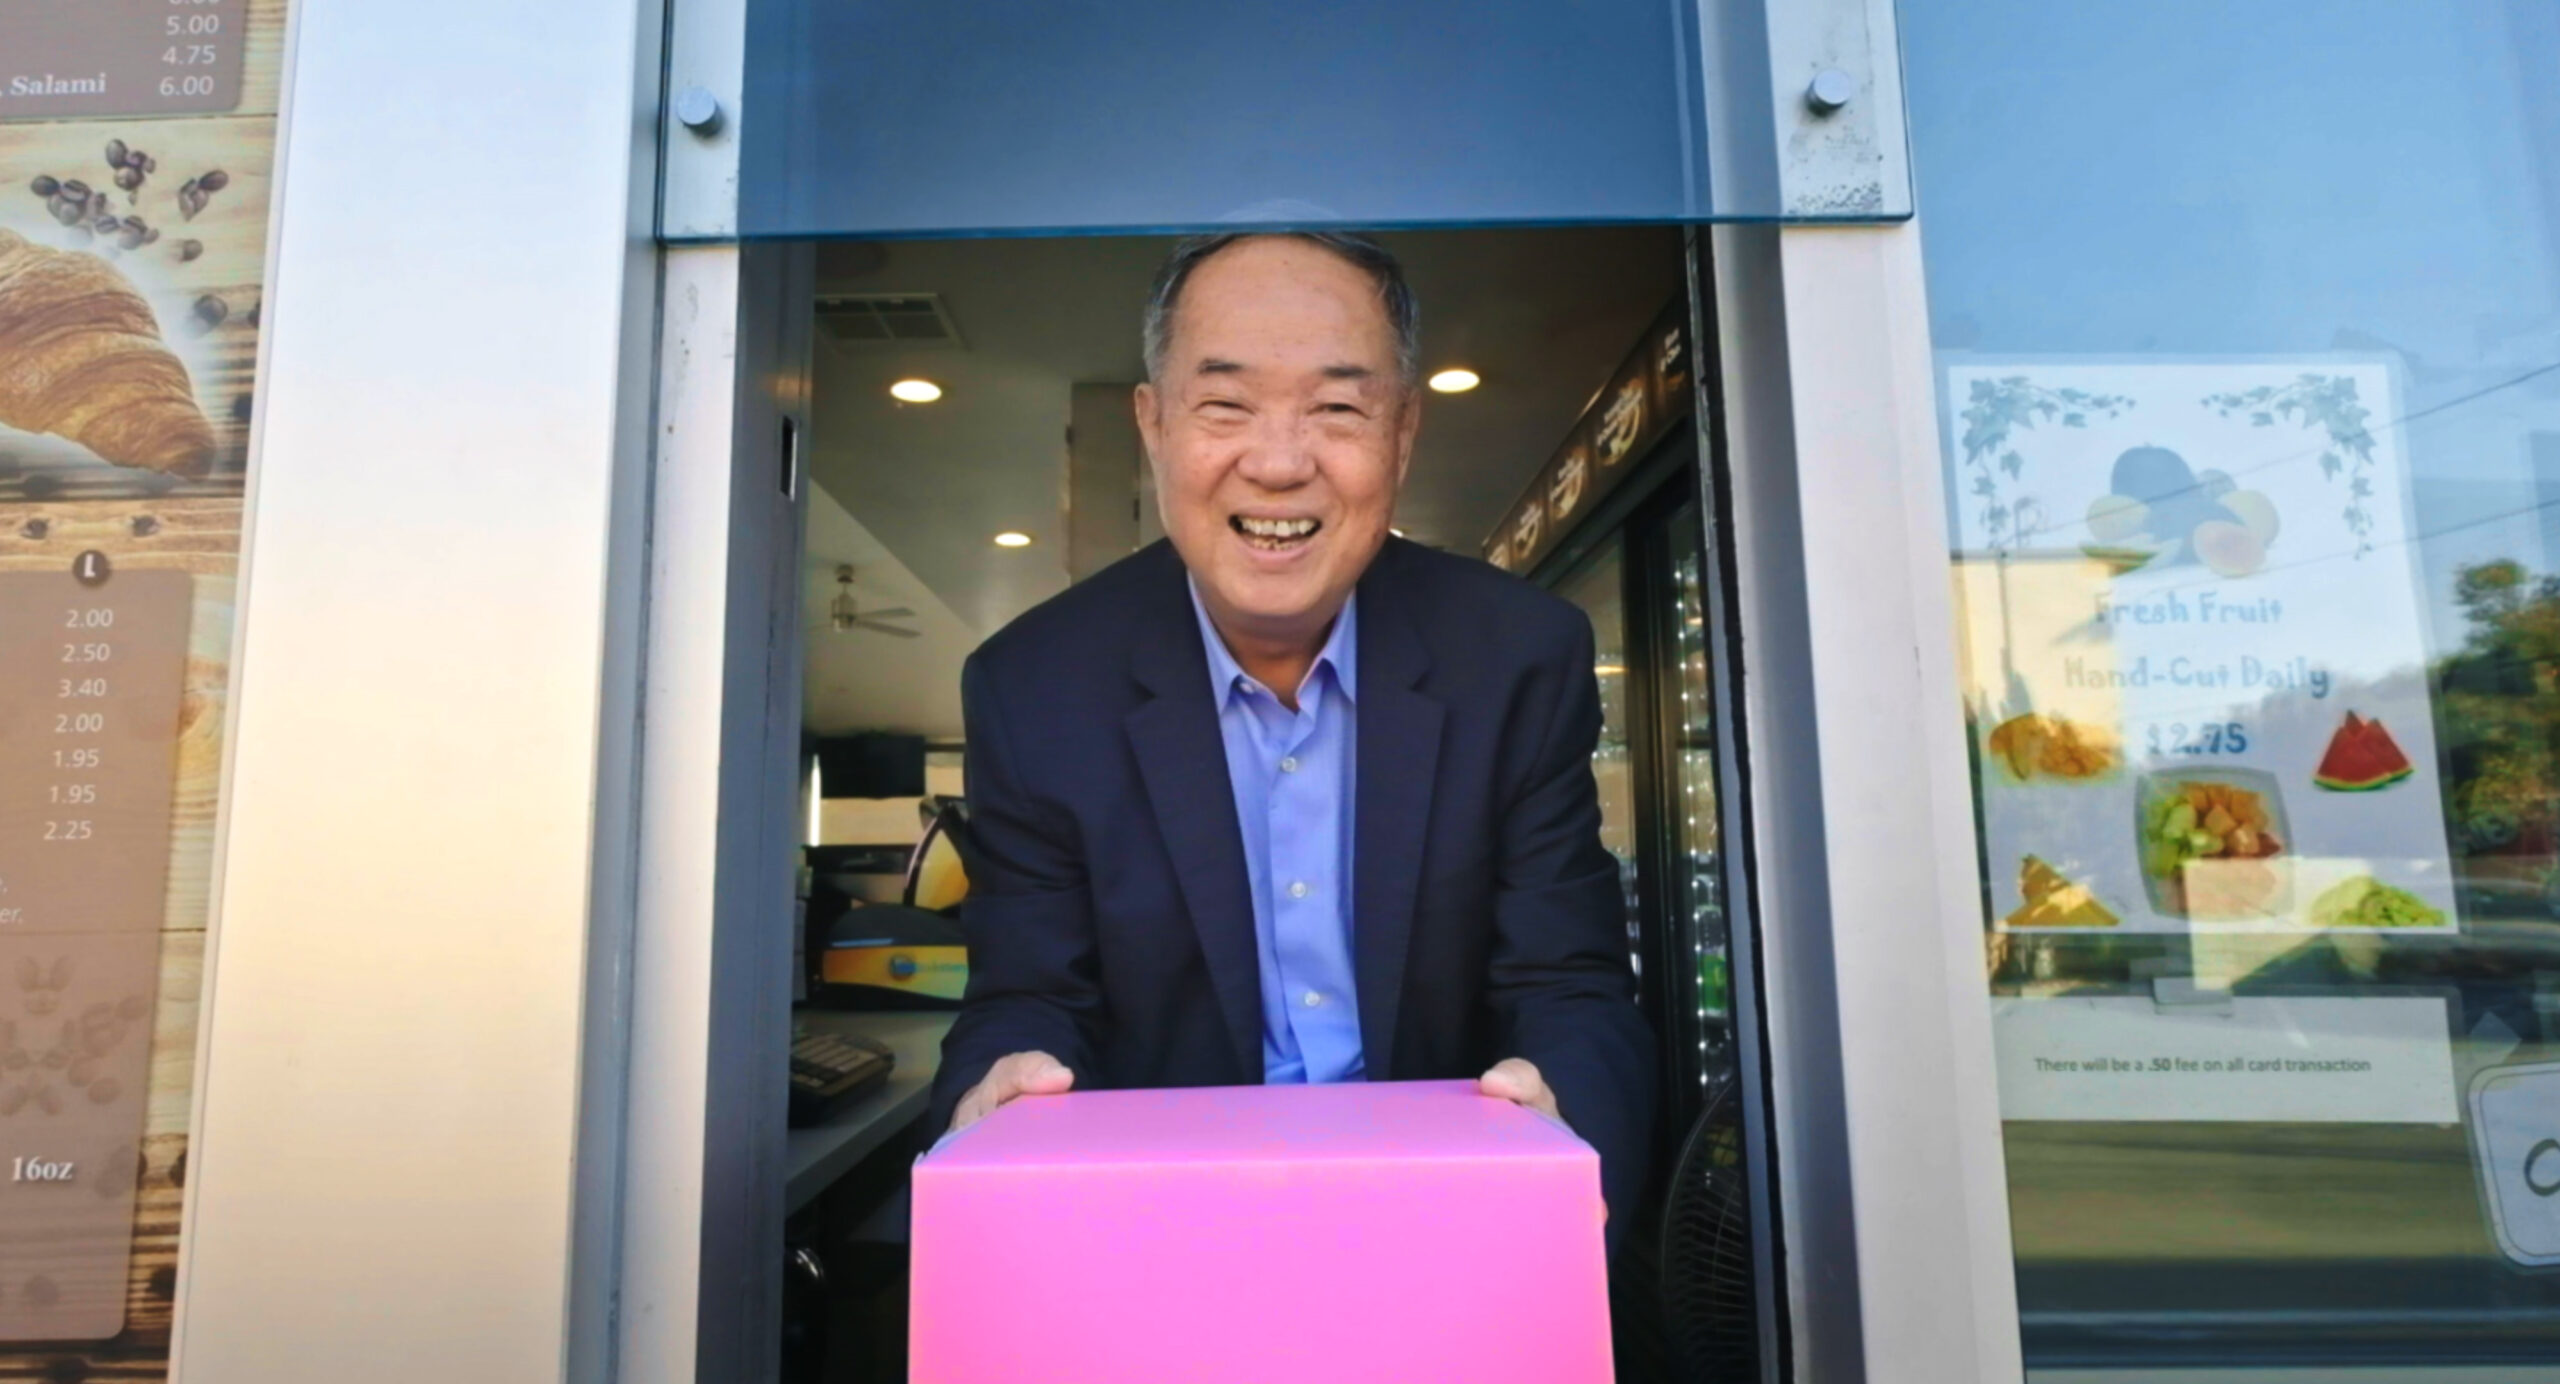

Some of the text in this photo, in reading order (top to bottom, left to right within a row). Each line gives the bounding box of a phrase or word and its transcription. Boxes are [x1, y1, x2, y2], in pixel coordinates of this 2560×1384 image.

[167, 15, 219, 35] 5.00
[162, 45, 216, 64] 4.75
[10, 73, 214, 96] Salami 6.00
[2094, 589, 2283, 624] Fresh Fruit
[66, 609, 113, 628] 2.00
[62, 644, 110, 663] 2.50
[2063, 655, 2329, 699] Hand-Cut Daily
[58, 678, 106, 698] 3.40
[55, 713, 103, 733] 2.00
[2146, 722, 2248, 754] $2.75
[53, 749, 100, 768] 1.95
[49, 784, 96, 804] 1.95
[44, 820, 92, 840] 2.25
[2035, 1056, 2372, 1072] There will be a .50 fee on all card transaction
[11, 1156, 74, 1181] 16oz
